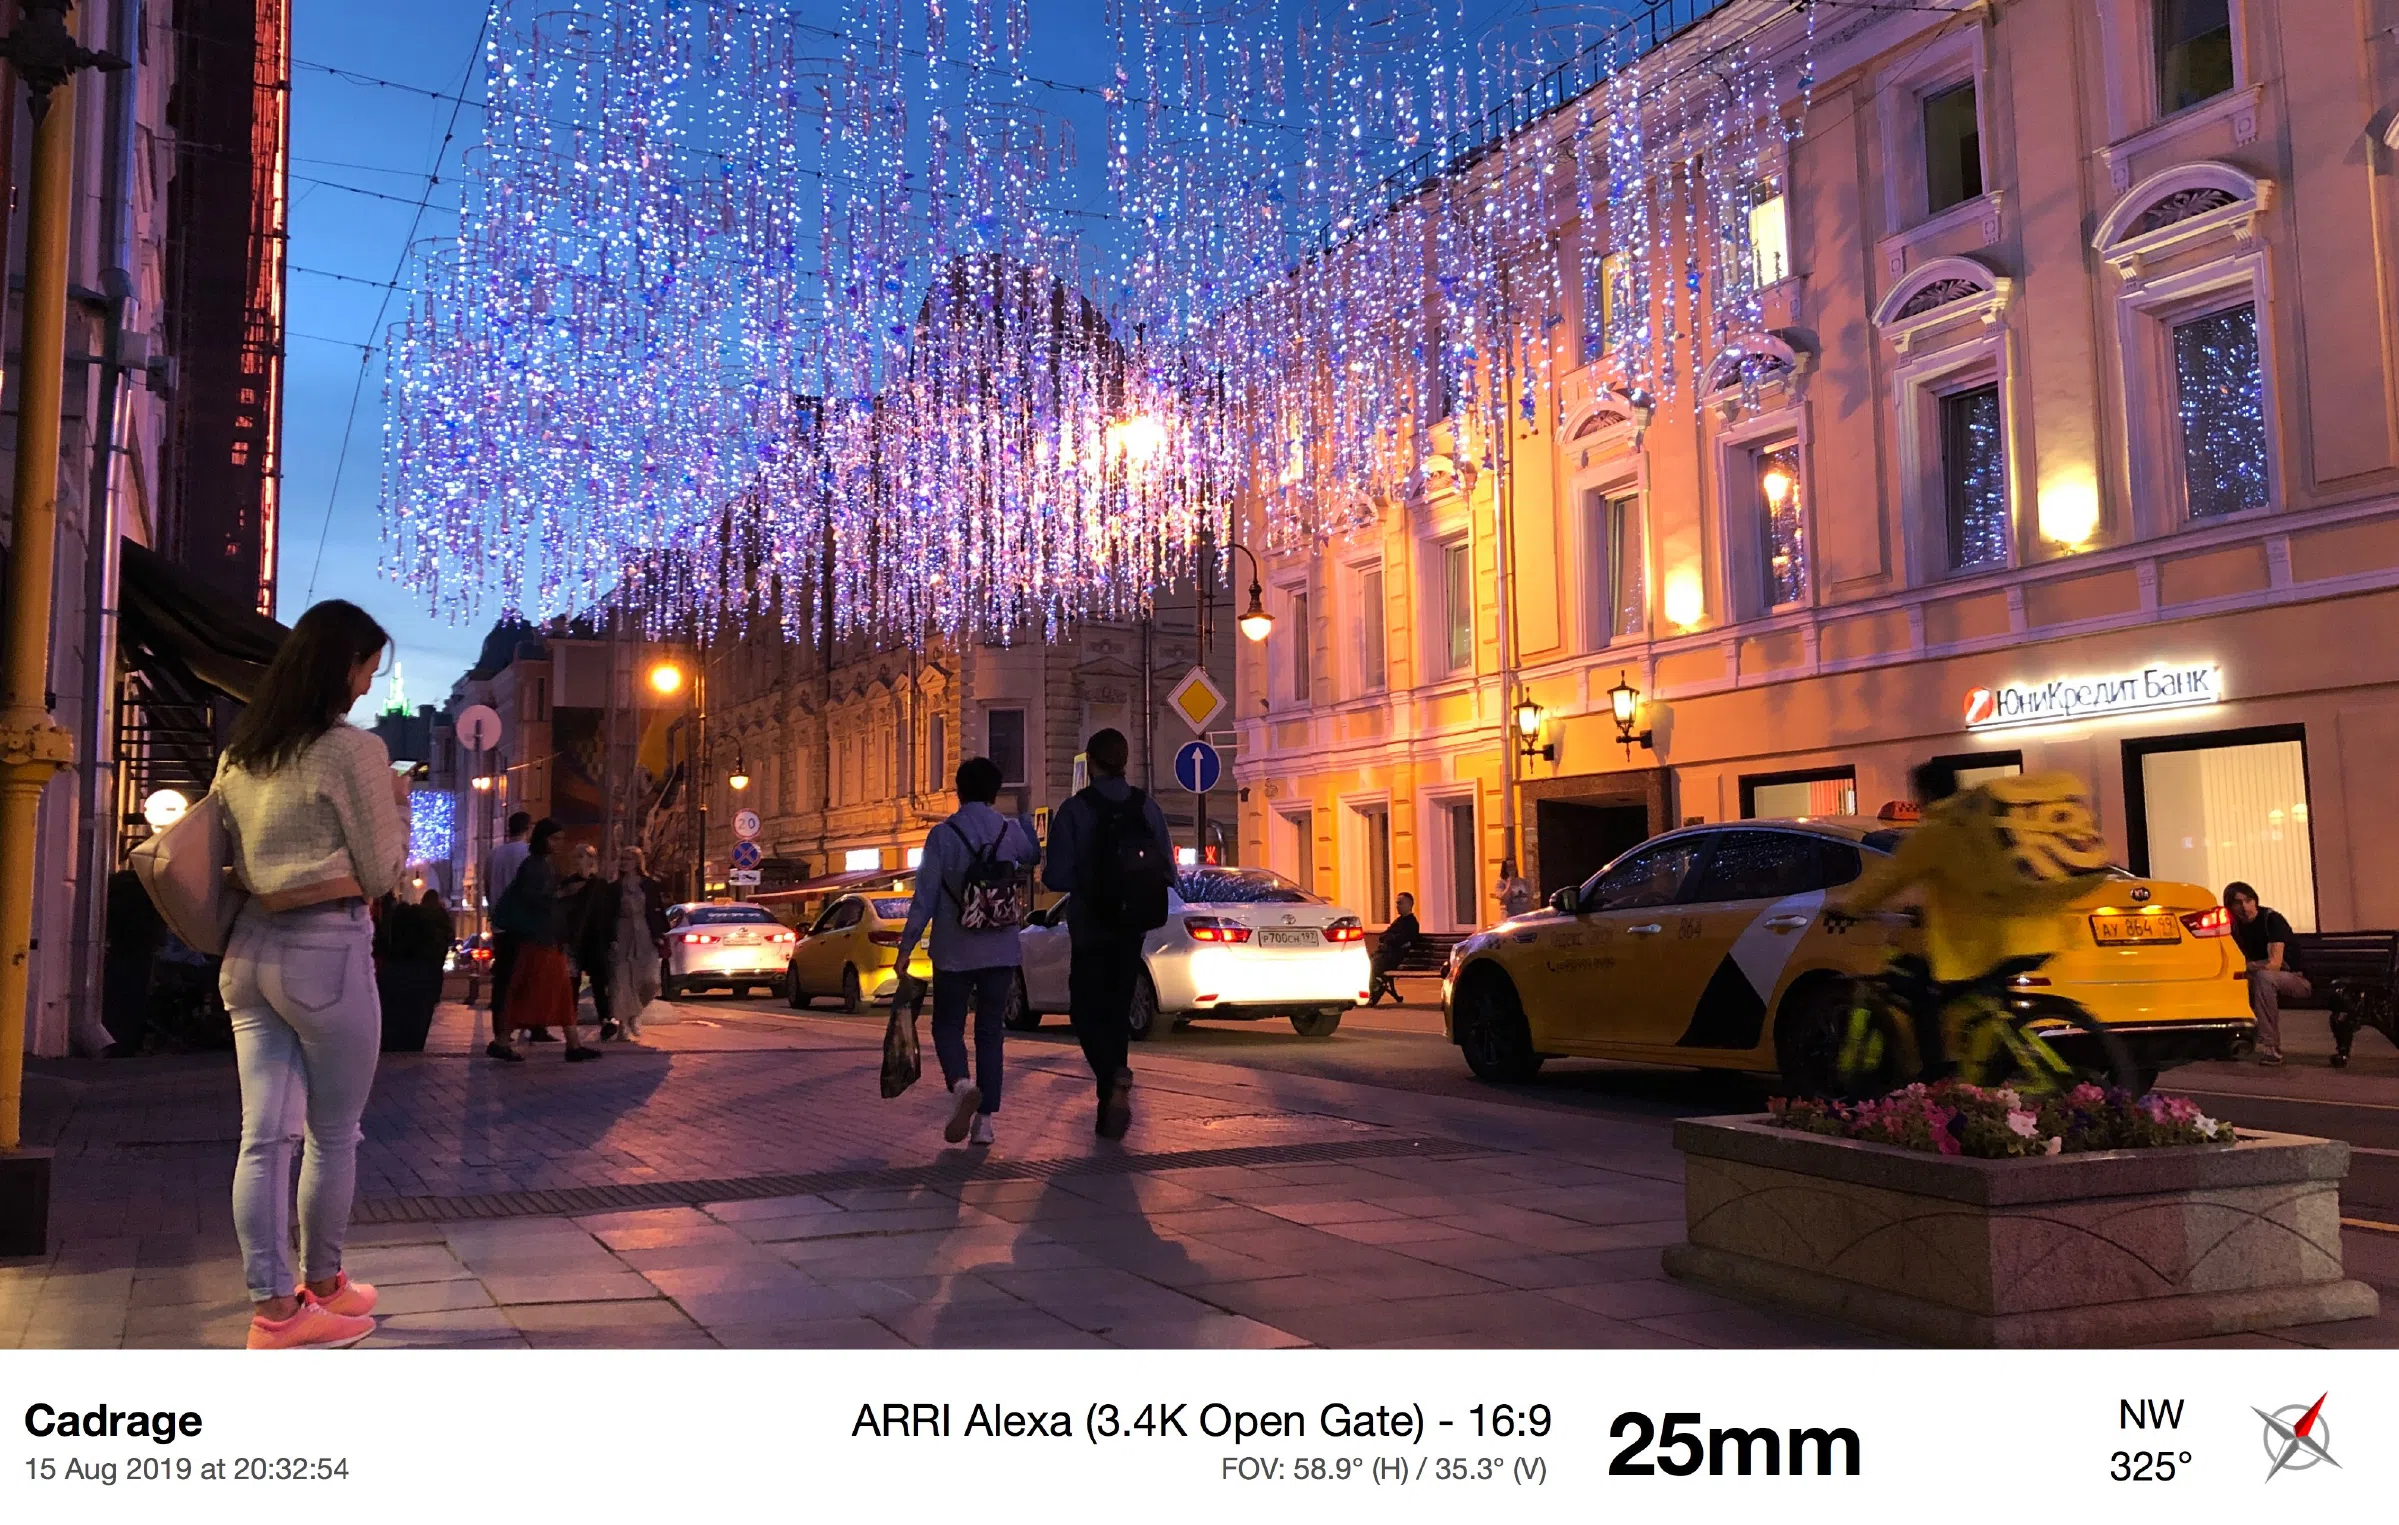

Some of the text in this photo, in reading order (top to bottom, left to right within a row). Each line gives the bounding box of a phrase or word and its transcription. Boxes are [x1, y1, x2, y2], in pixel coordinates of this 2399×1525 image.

[1996, 669, 2209, 717] ЮниКредит Банк
[738, 818, 755, 830] 20
